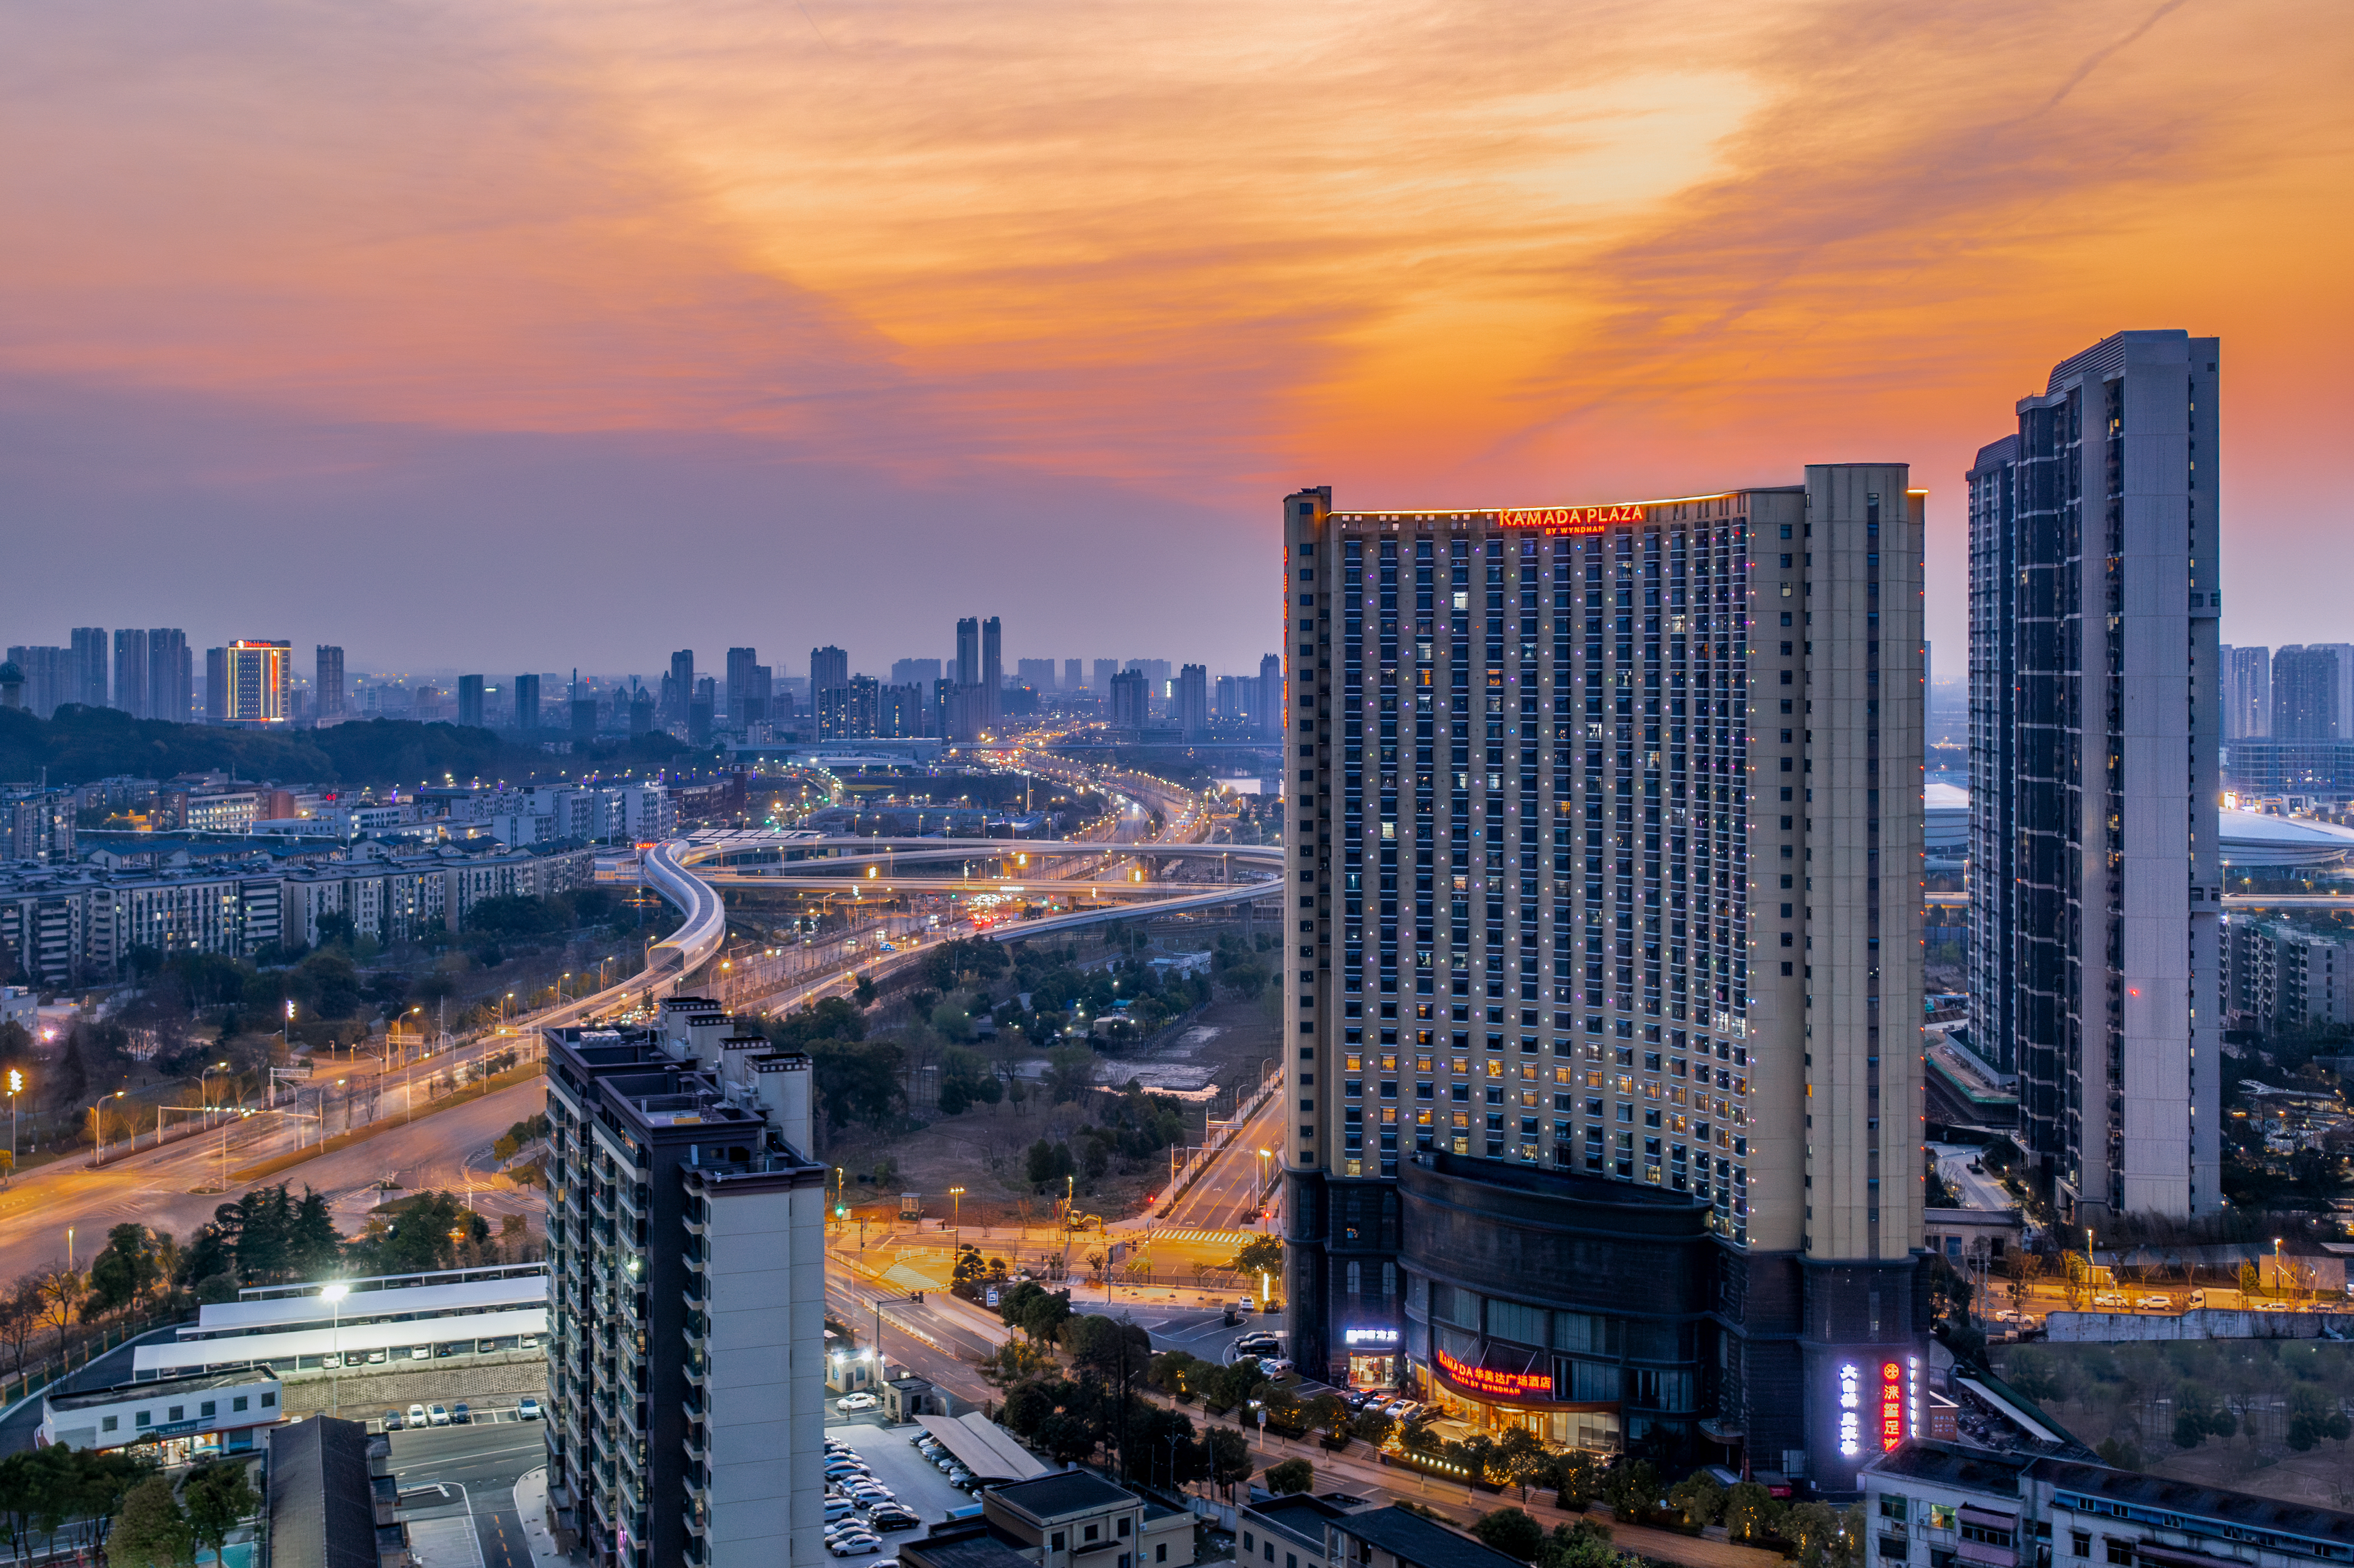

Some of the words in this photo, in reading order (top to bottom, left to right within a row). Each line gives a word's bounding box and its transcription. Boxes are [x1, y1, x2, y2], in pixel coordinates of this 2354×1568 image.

[1499, 508, 1580, 526] RAMADA
[1587, 505, 1643, 523] PLAZA
[1561, 525, 1604, 534] WYNDHAM
[1439, 1349, 1473, 1378] RAMADA
[1452, 1372, 1469, 1385] PLAZA
[1482, 1382, 1520, 1394] WYNDHAM
[1475, 1367, 1551, 1389] 华美达广场酒店
